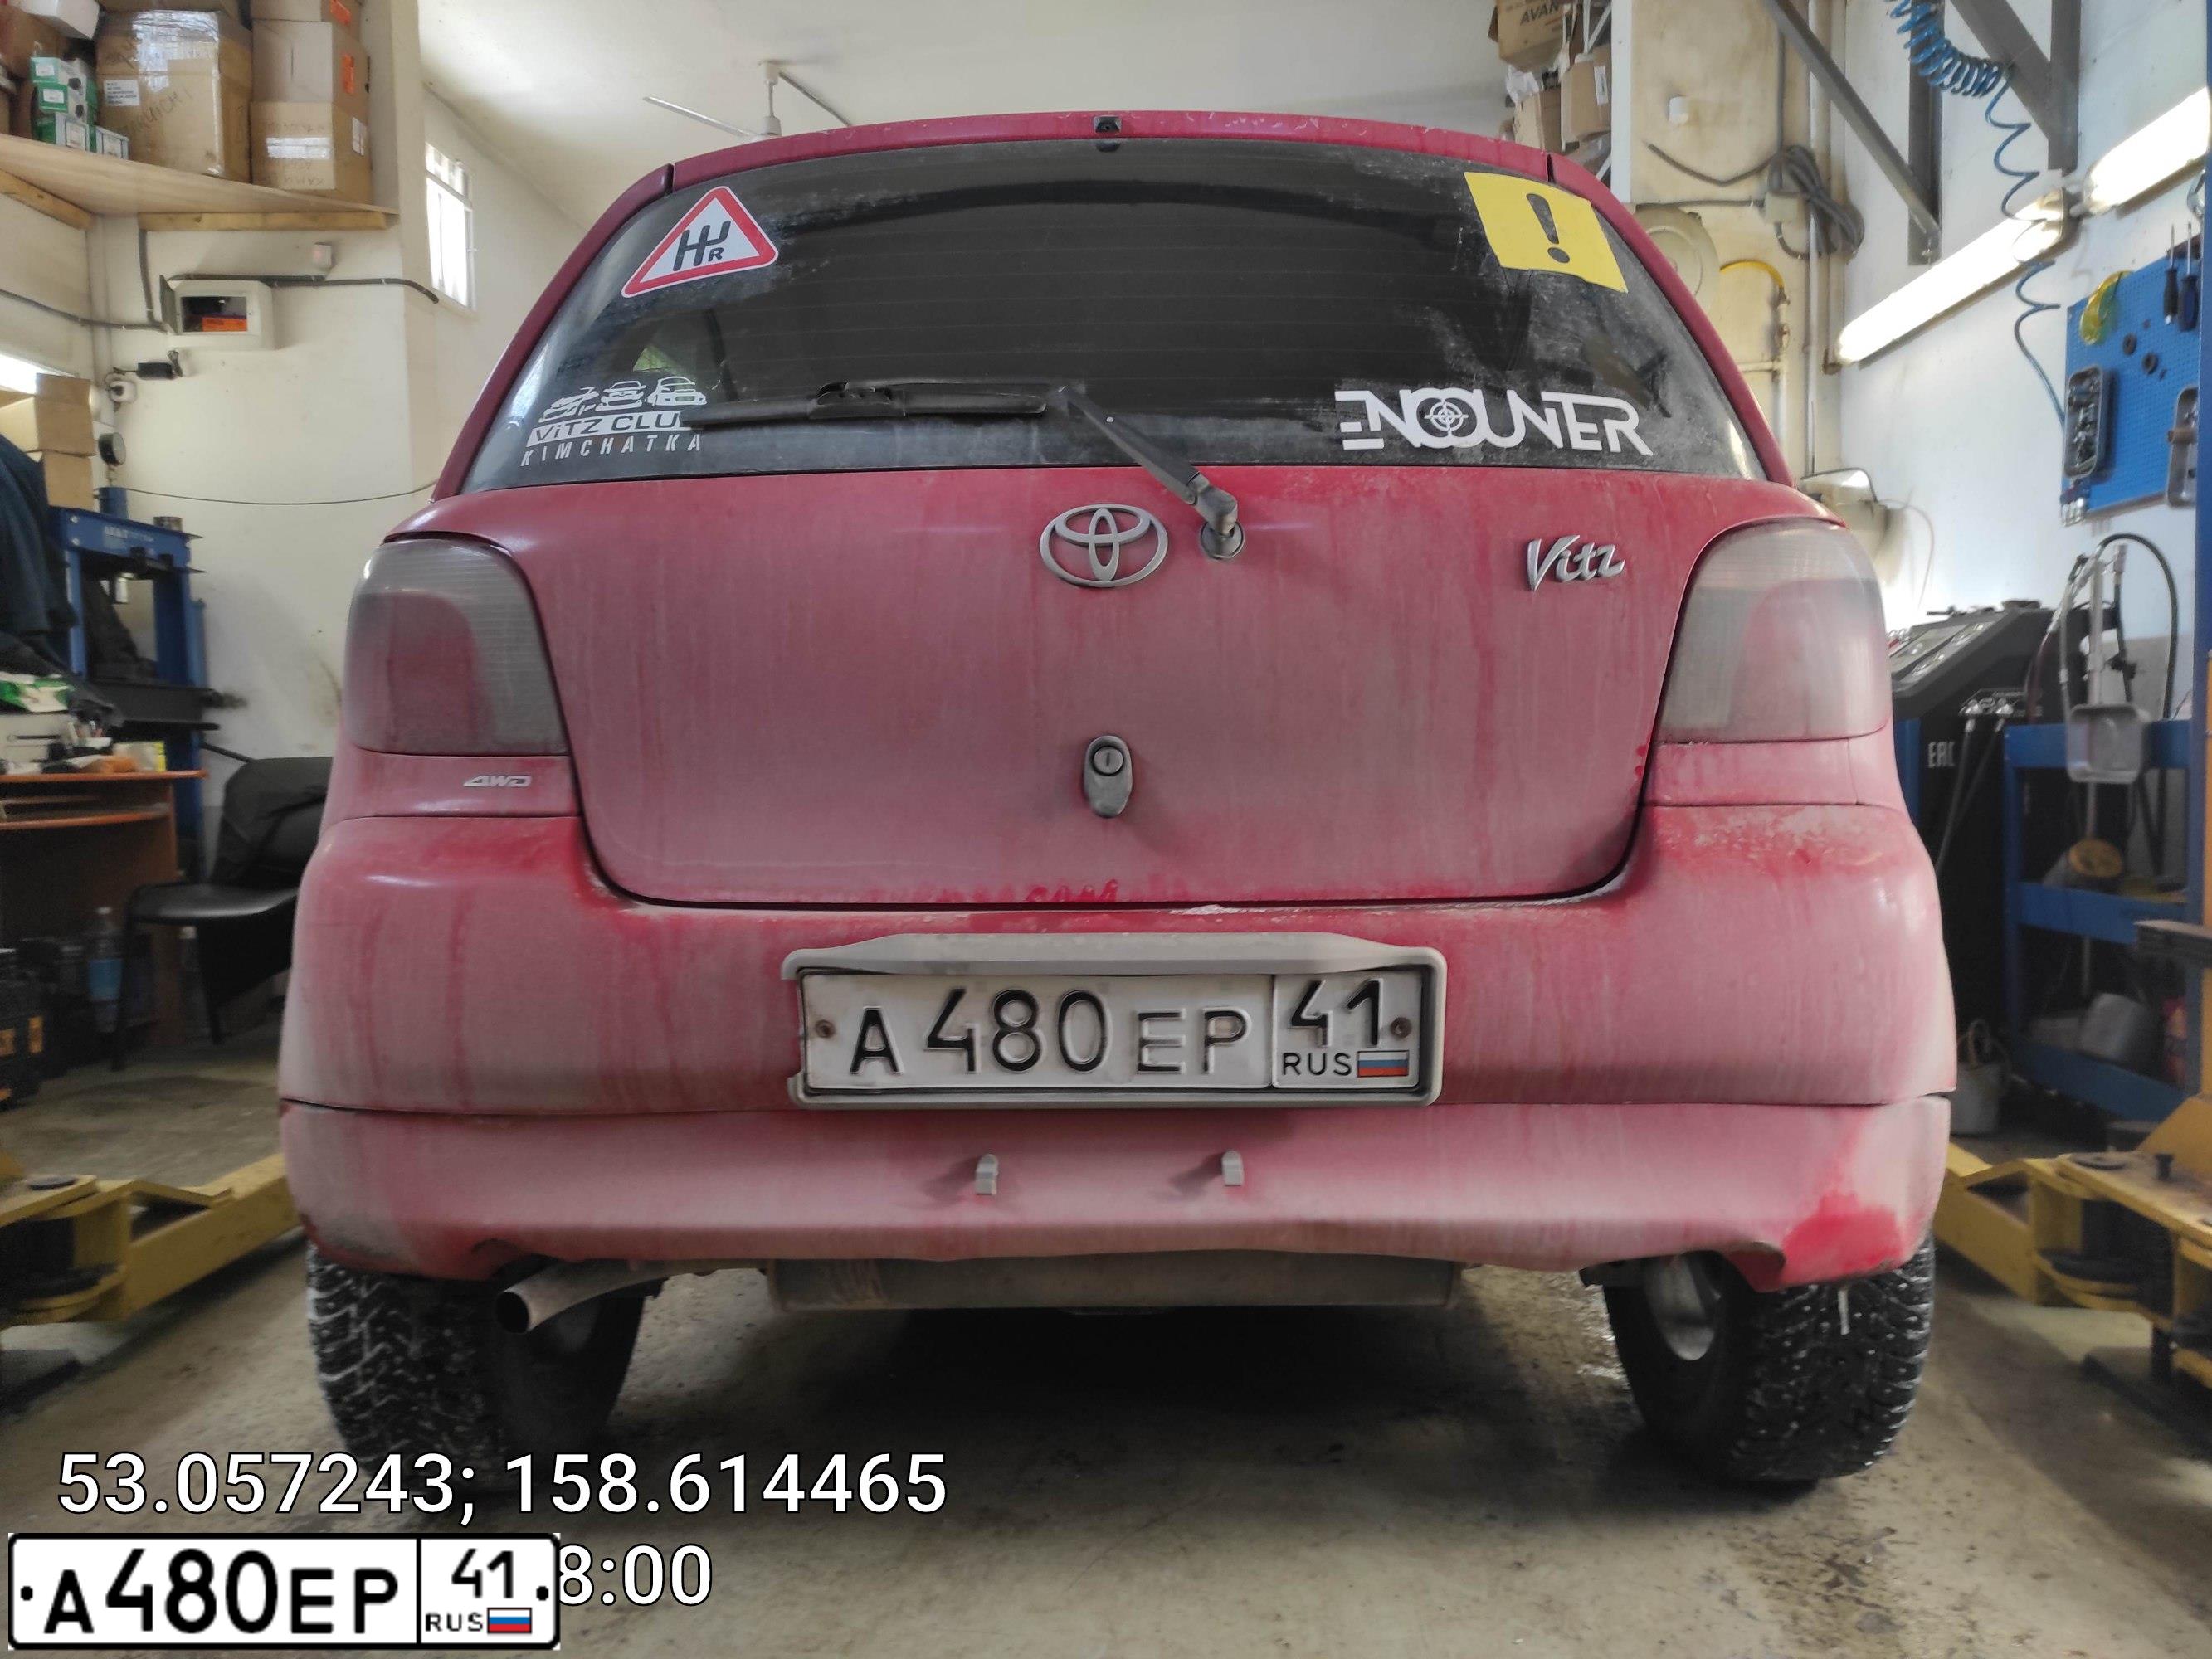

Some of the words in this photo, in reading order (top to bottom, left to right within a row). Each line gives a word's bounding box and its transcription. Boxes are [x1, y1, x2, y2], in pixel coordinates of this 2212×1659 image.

[520, 434, 701, 467] KIMCHATKA
[1527, 534, 1626, 591] Vitz
[463, 775, 532, 787] 4WD
[1289, 979, 1384, 1047] 41
[1281, 1053, 1353, 1077] RUS
